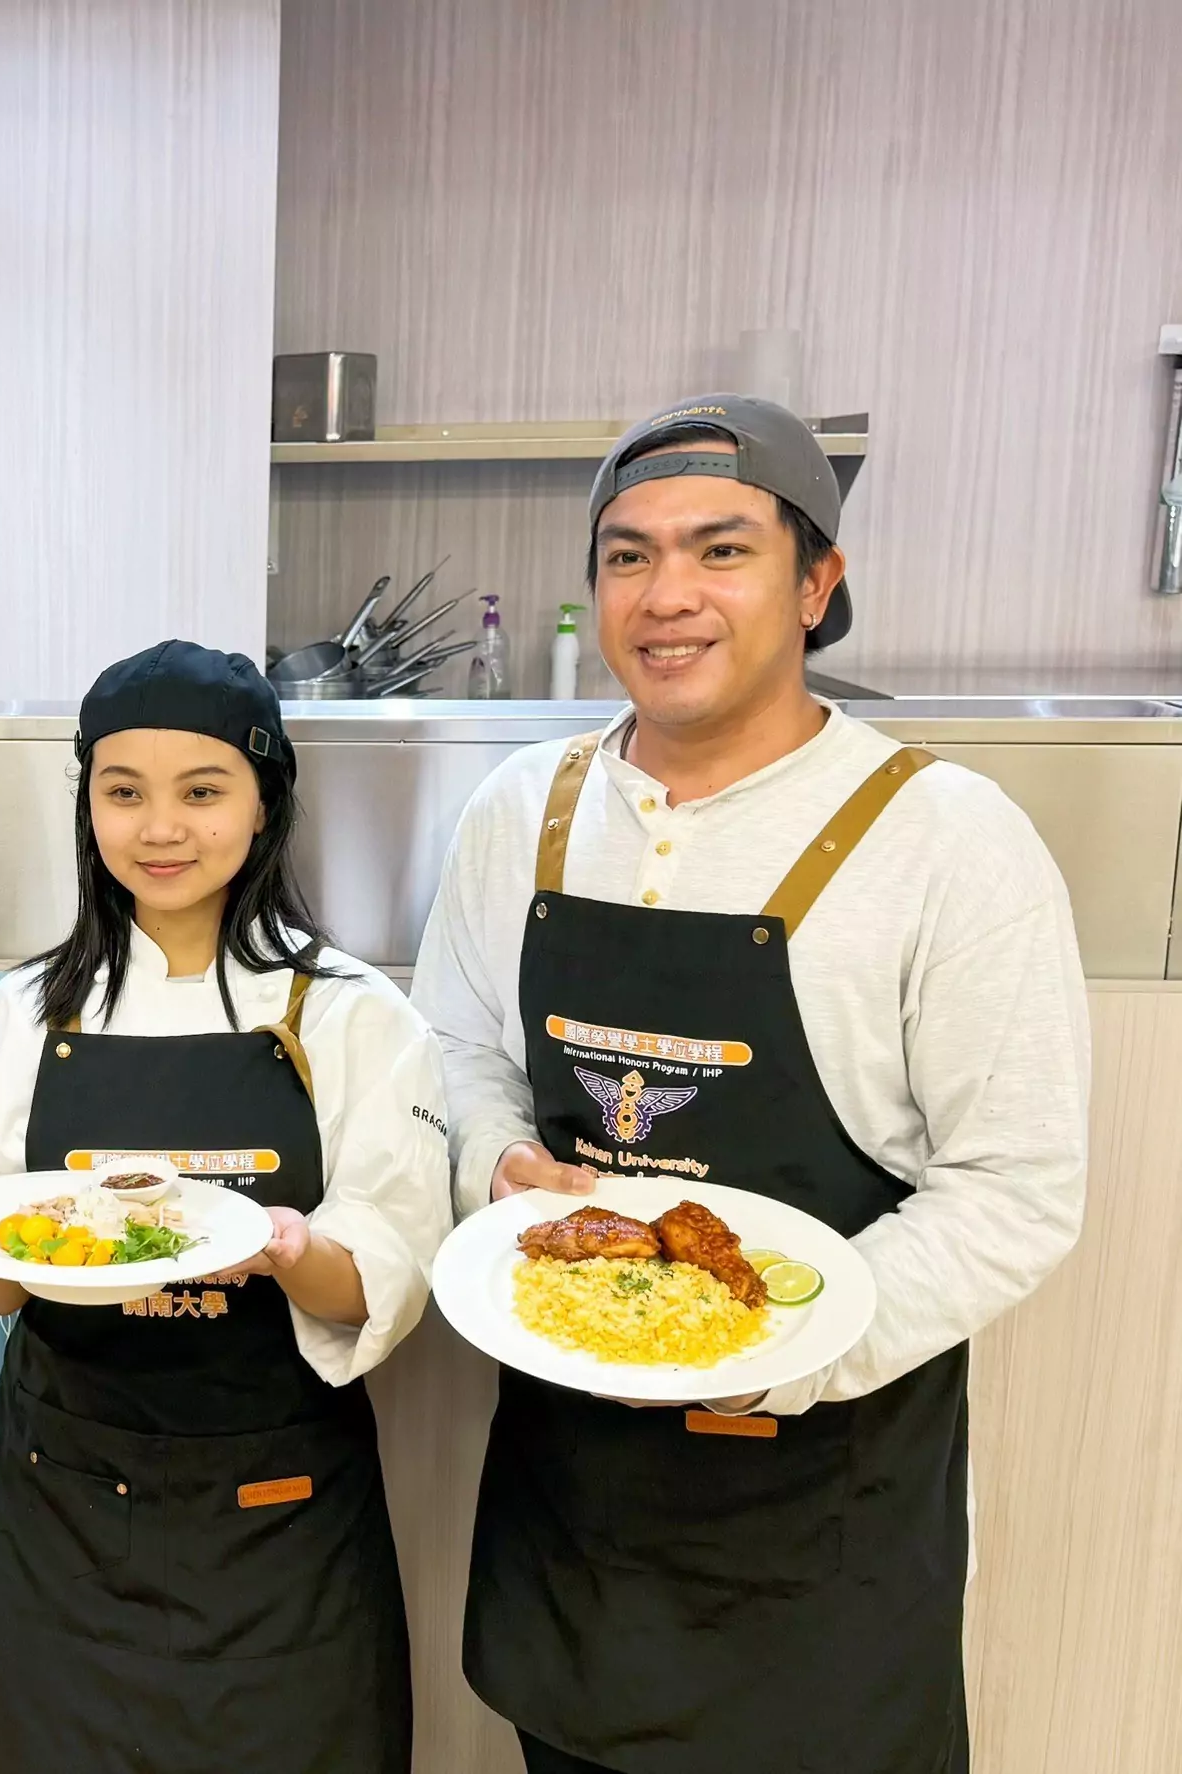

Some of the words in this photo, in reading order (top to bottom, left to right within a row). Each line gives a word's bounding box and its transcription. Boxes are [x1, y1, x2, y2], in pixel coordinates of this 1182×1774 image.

[563, 1022, 725, 1063] 國際榮譽學士學位學程
[563, 1045, 616, 1063] International
[618, 1055, 650, 1070] Honors
[652, 1061, 689, 1077] Program
[702, 1068, 724, 1079] IHP
[575, 1136, 613, 1165] Kainan
[617, 1150, 710, 1179] University
